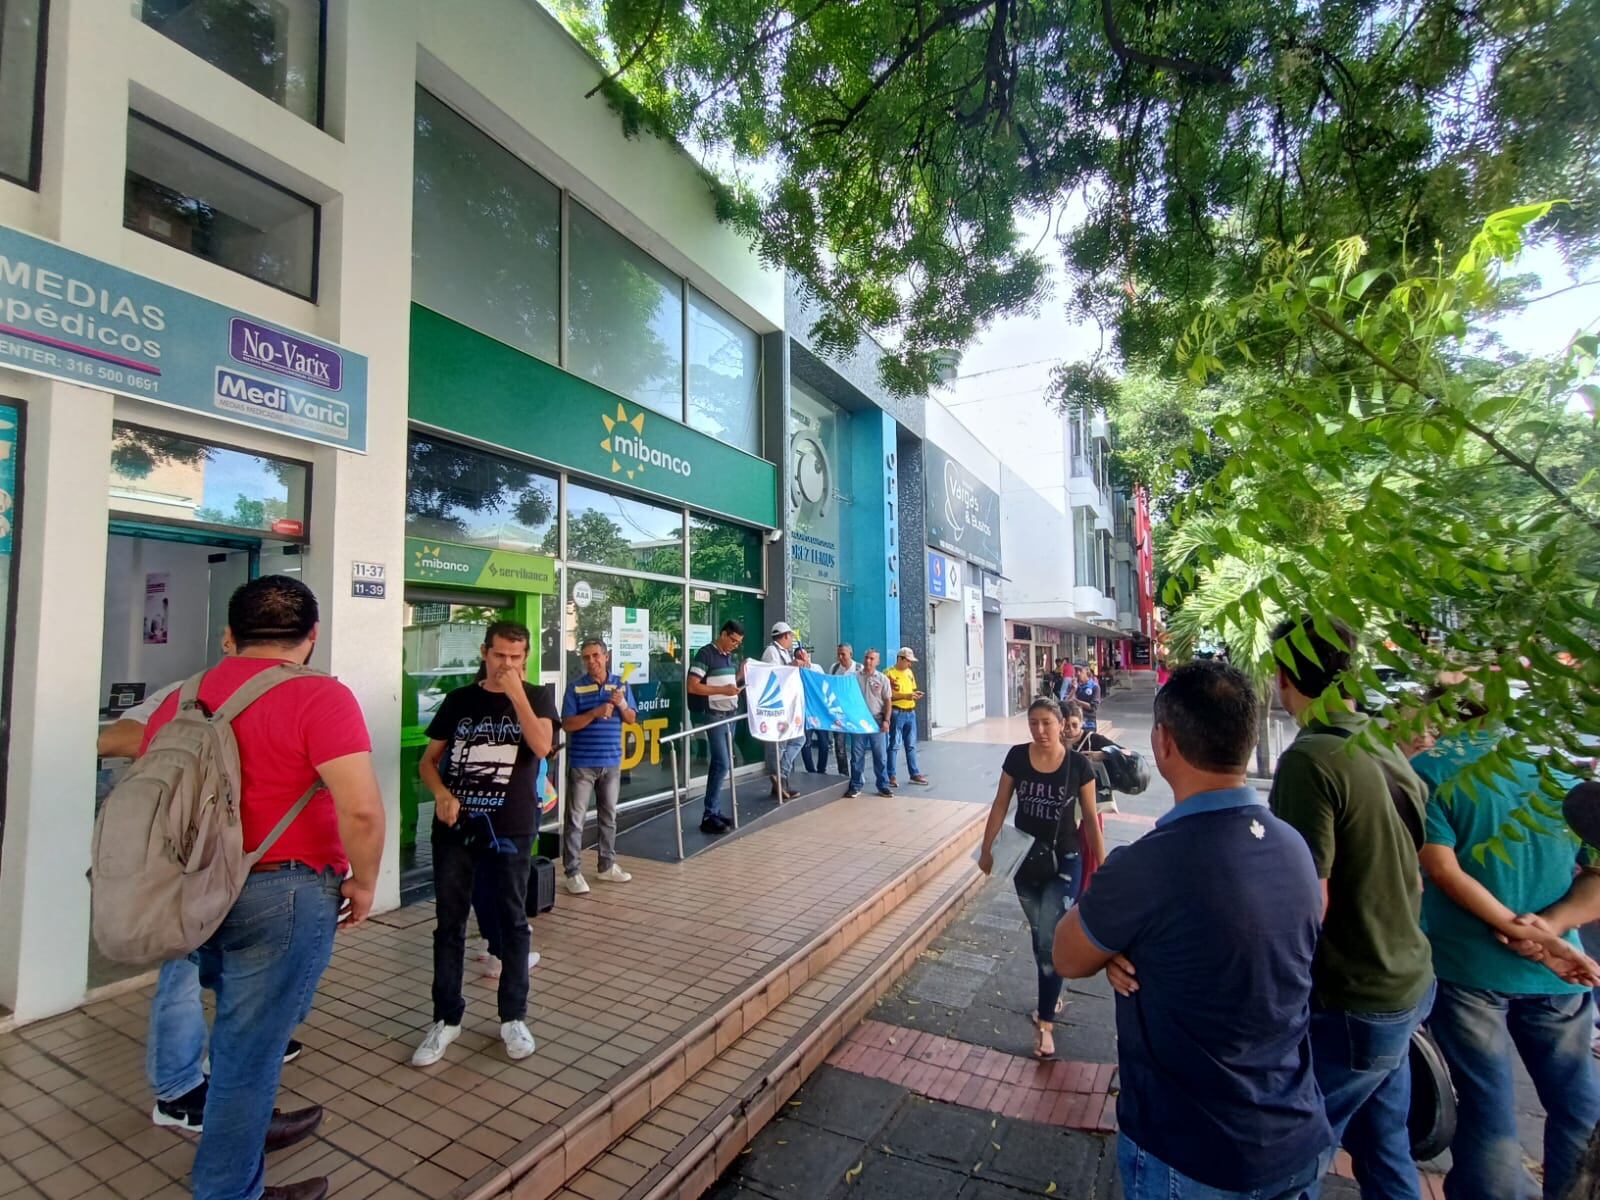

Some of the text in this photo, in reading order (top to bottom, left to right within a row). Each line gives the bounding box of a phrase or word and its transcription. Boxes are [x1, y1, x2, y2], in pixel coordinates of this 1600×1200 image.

[0, 255, 165, 331] MEDIAS
[0, 297, 161, 358] pédicos
[242, 328, 331, 379] No-Varix
[67, 358, 94, 375] 316
[98, 367, 123, 383] 500
[615, 432, 691, 477] mibanco
[355, 564, 384, 577] 11-37
[422, 558, 469, 573] mibanco
[355, 583, 383, 595] 11-39
[638, 697, 670, 712] aquí tu
[1020, 780, 1065, 800] GIRLS
[465, 796, 505, 806] BRIDGE
[1023, 801, 1060, 820] GIRLS
